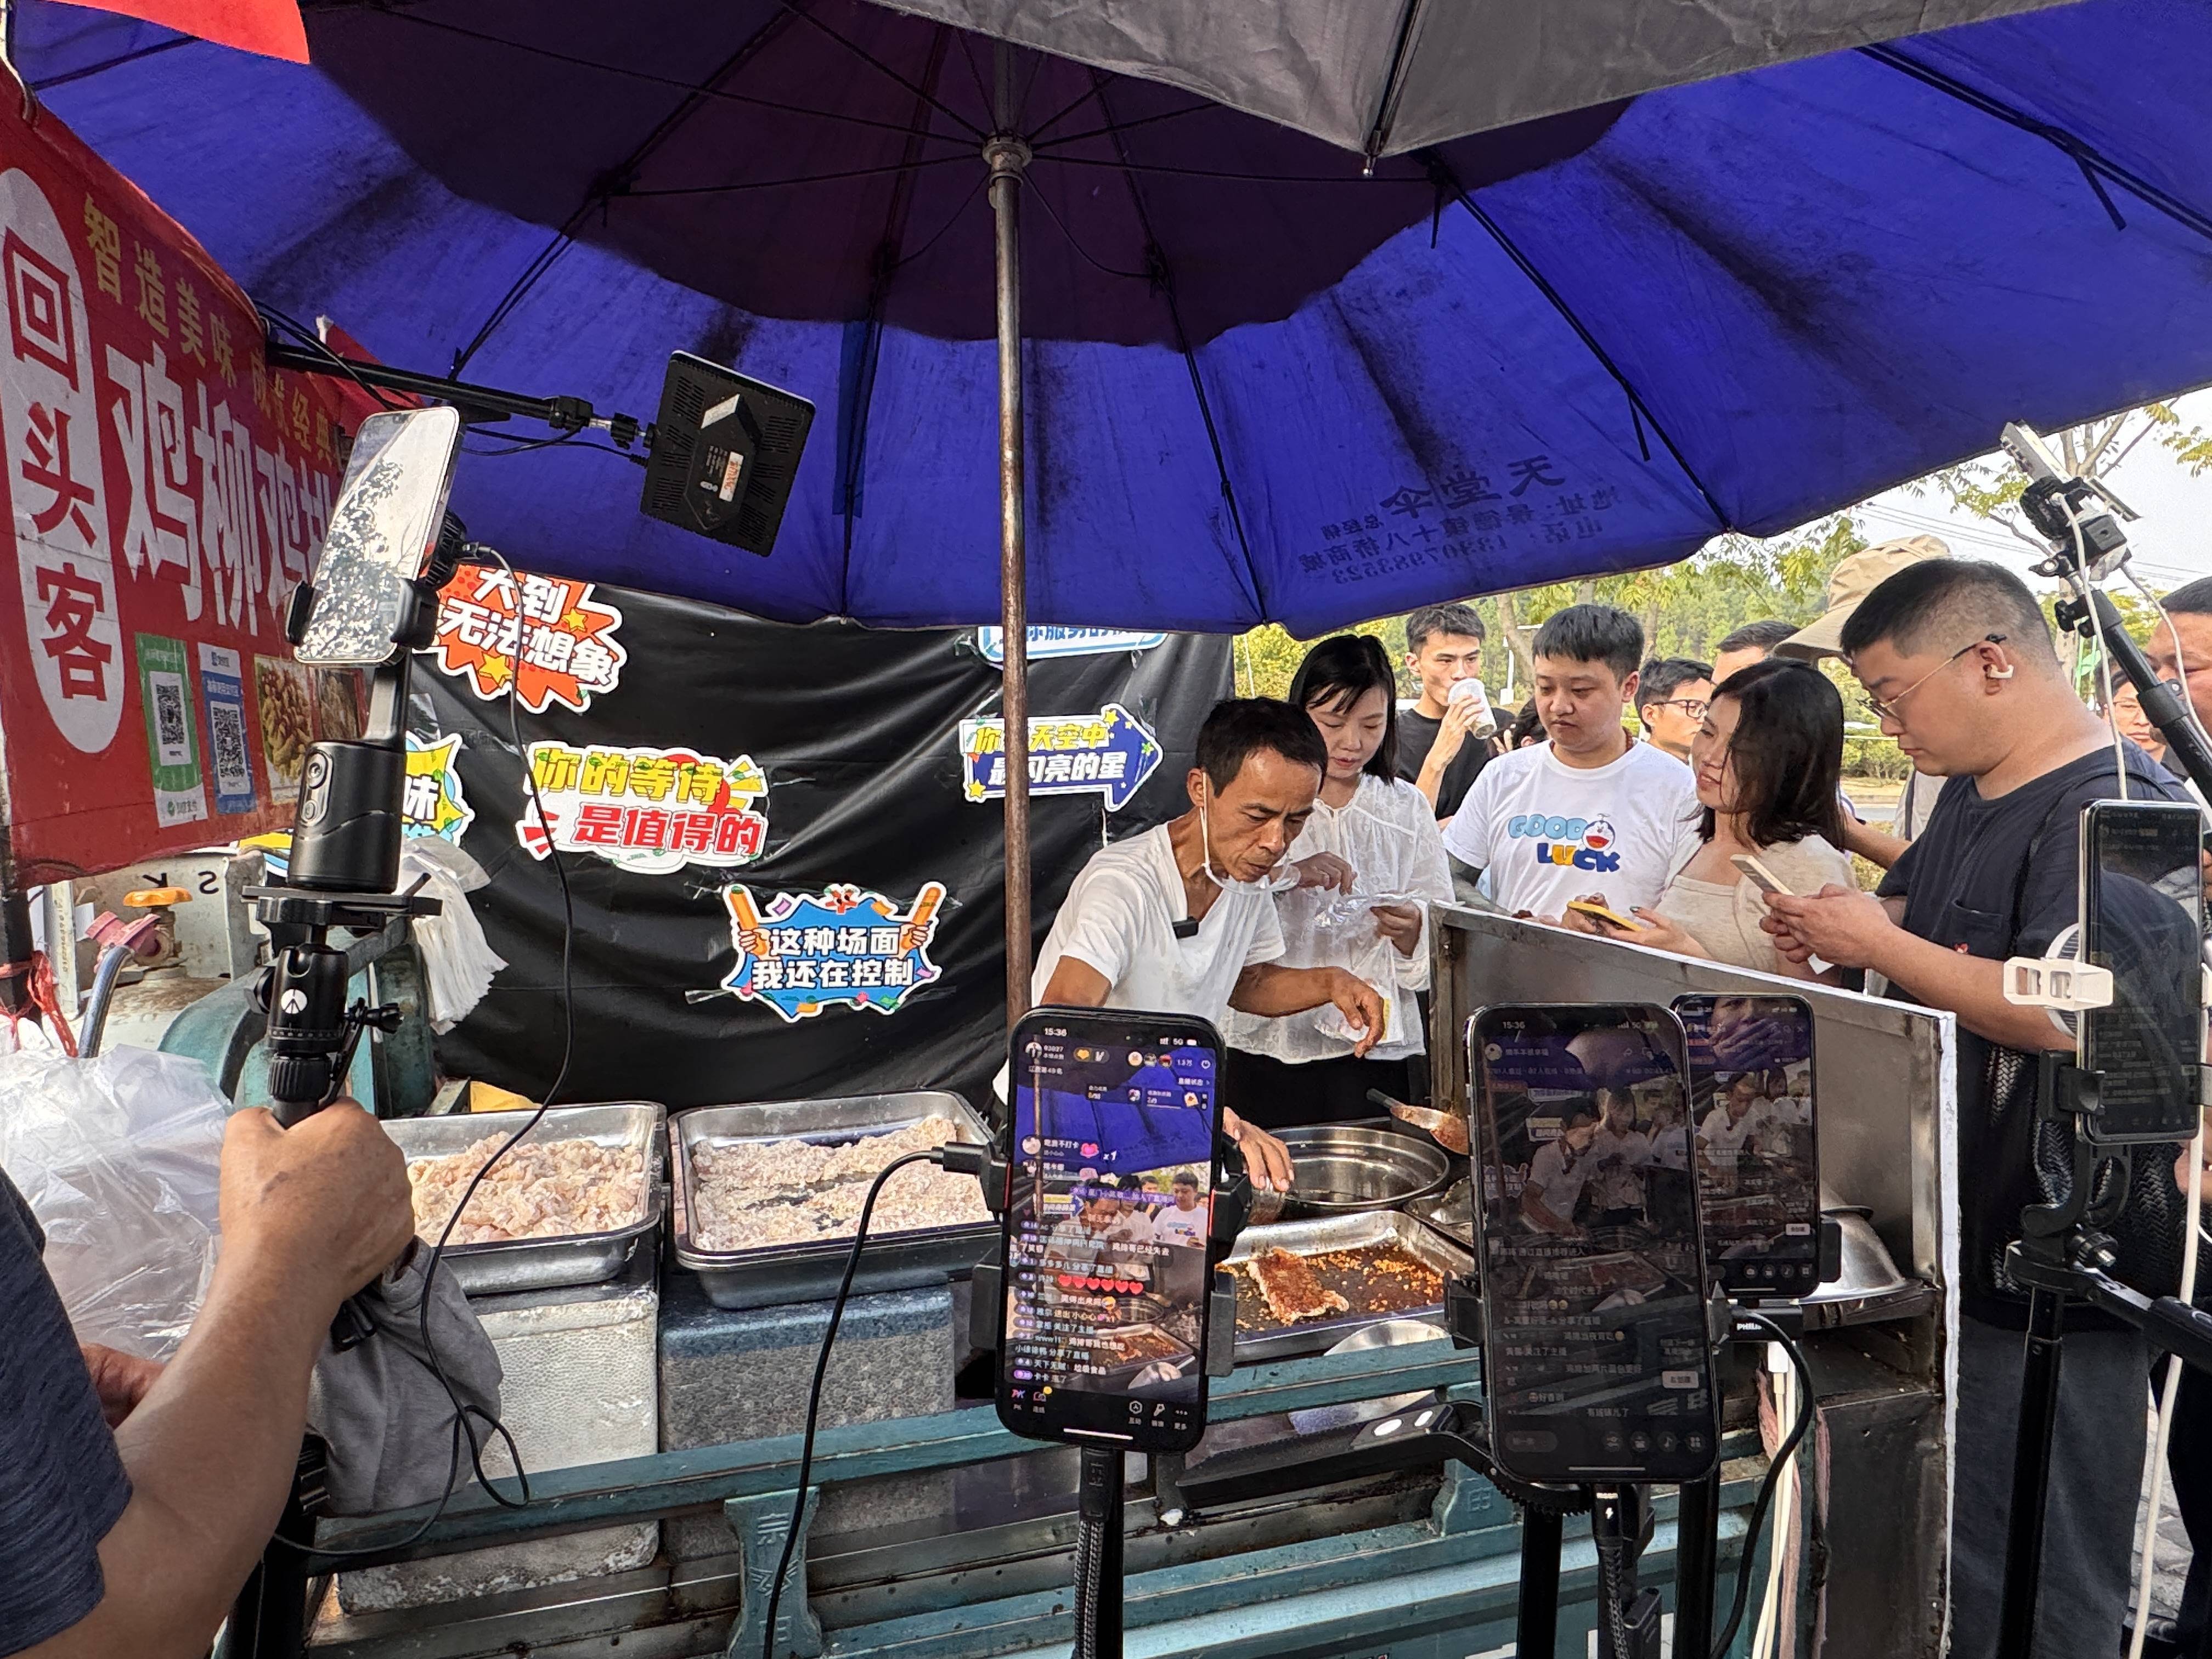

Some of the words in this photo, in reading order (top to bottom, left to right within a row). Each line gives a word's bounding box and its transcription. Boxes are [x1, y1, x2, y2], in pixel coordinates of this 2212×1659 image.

[2, 226, 113, 702] 回头客
[437, 596, 612, 686] 无法想象
[974, 723, 1109, 754] 你天空中
[533, 747, 724, 805] 你的等待
[571, 803, 762, 855] 是值得的
[1508, 813, 1588, 840] GOOD
[1537, 842, 1621, 872] LUCK
[769, 926, 901, 957] 这种场面
[751, 958, 915, 990] 我还在控制
